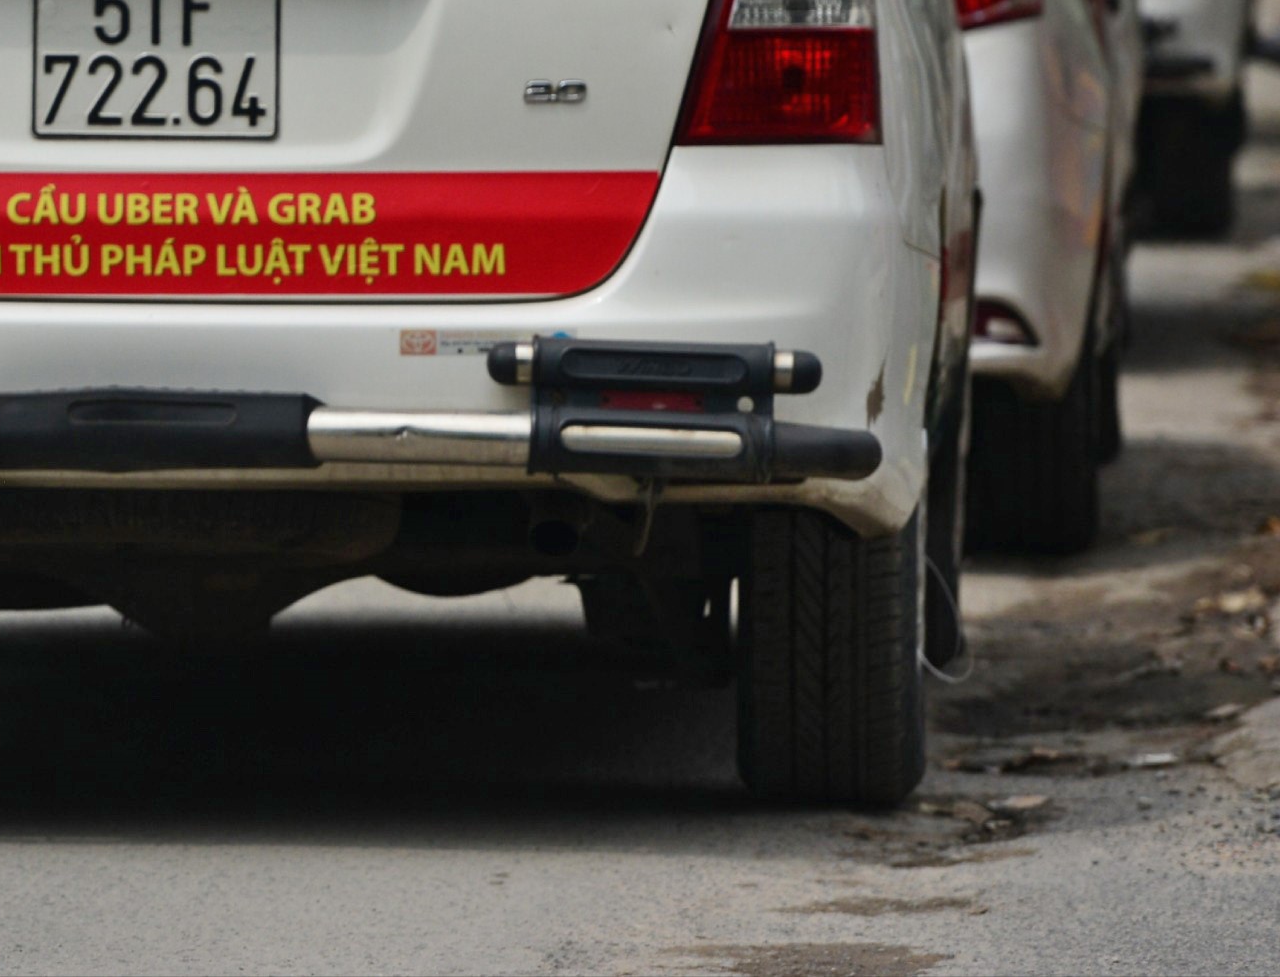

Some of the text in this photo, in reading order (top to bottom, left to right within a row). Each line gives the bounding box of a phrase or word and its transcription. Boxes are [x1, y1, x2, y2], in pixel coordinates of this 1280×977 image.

[43, 54, 267, 128] 722.64
[96, 191, 200, 225] UBER
[205, 185, 259, 225] VÀ
[267, 191, 377, 225] GRAB
[8, 234, 91, 277] THỦ
[100, 237, 207, 276] PHÁP
[216, 237, 312, 285] LUẬT
[318, 236, 405, 285] VIỆT
[413, 243, 506, 276] NAM
